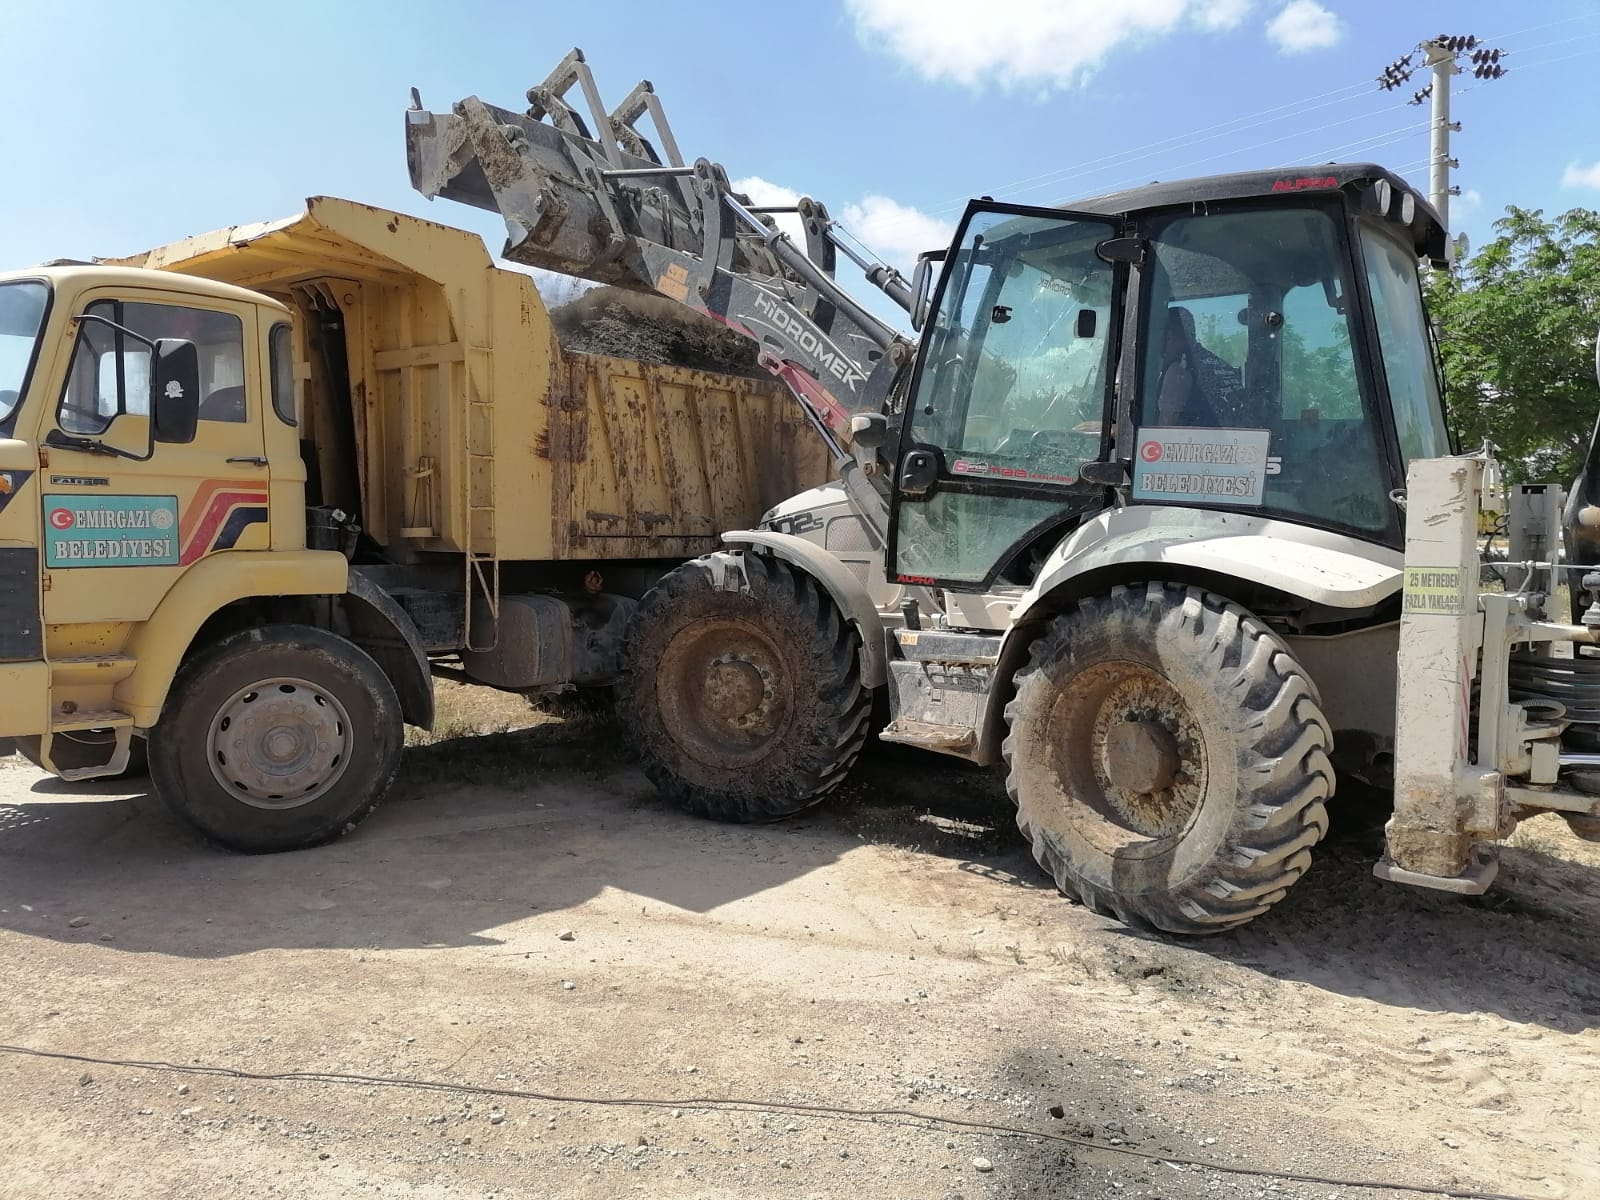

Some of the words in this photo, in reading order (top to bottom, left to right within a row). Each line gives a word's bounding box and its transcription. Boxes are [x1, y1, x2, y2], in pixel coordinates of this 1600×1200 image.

[1272, 176, 1337, 192] ALPHA
[1162, 437, 1238, 464] EMİRGAZİ
[1141, 469, 1257, 497] BELEDİYESİ
[75, 505, 151, 530] EMİRGAZİ
[54, 534, 172, 560] BELEDİYESİ
[896, 574, 936, 586] ALPHA
[1409, 572, 1419, 588] 25
[1420, 572, 1460, 588] METREDEN
[1405, 593, 1426, 609] FAZLA
